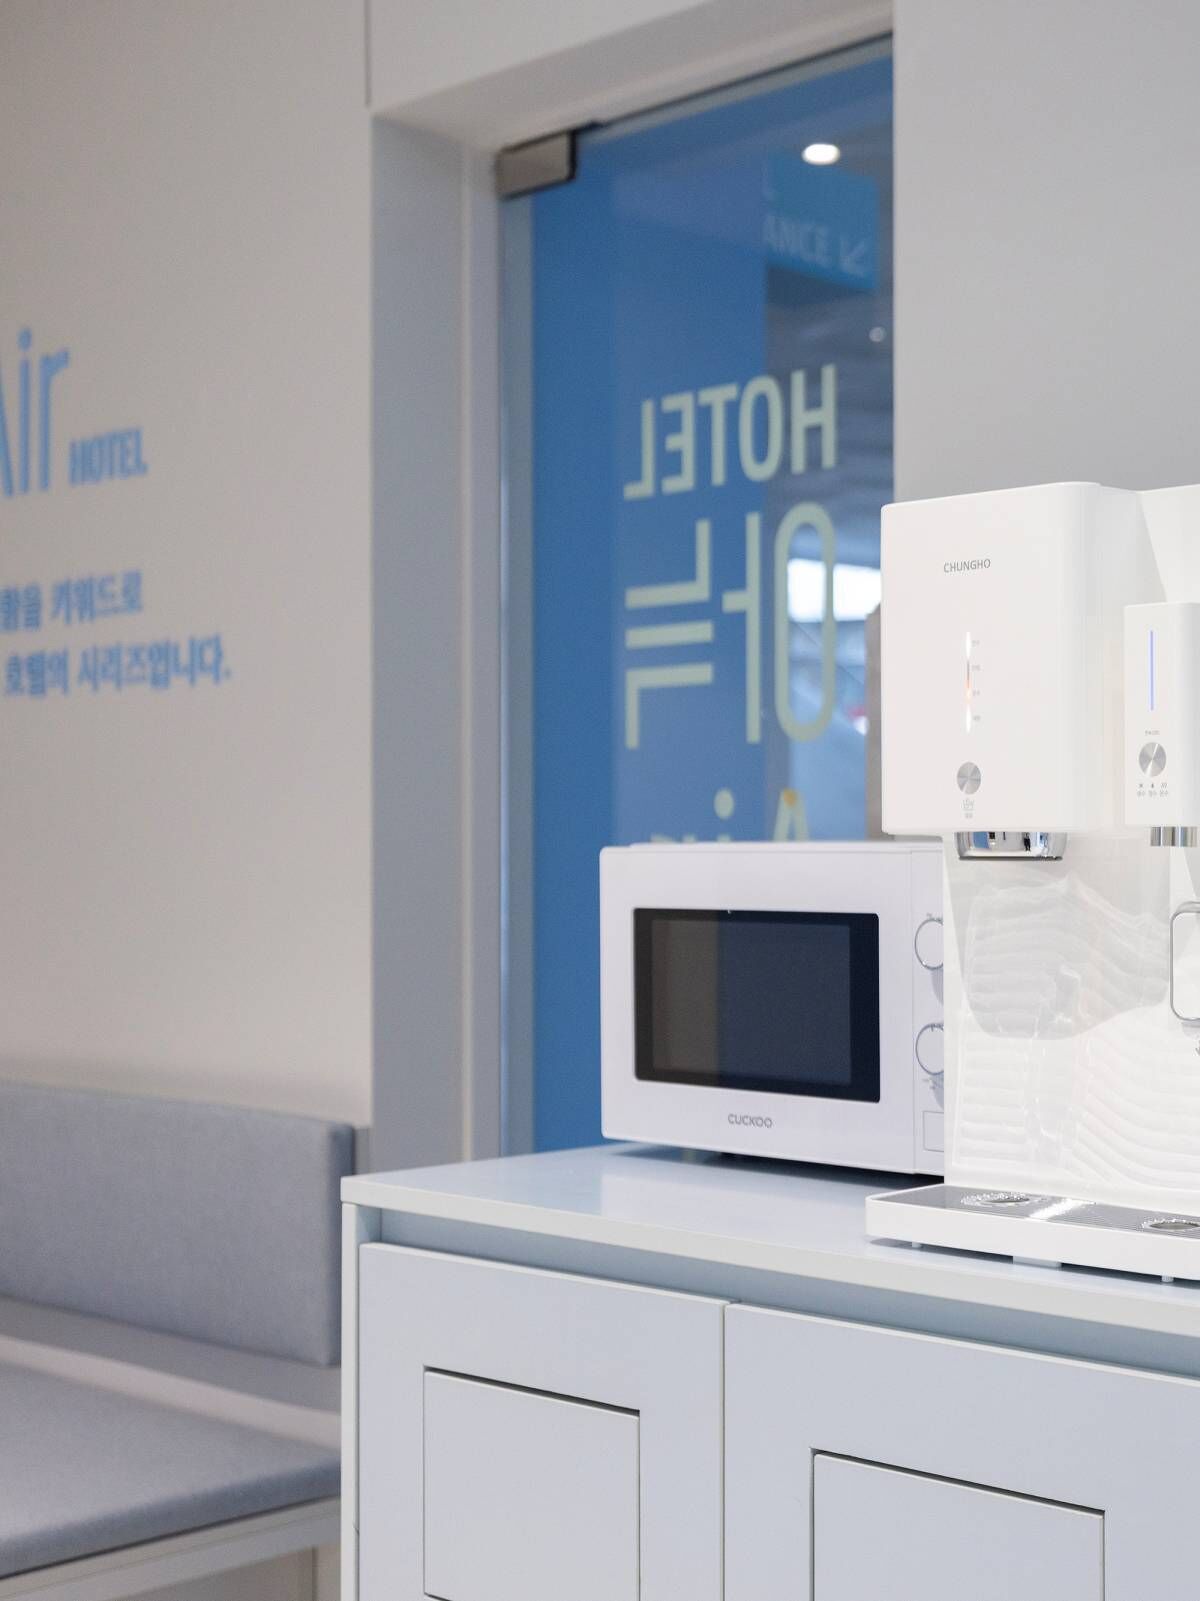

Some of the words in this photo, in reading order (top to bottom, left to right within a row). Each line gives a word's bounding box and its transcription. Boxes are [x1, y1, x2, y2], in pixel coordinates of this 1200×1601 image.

[69, 428, 148, 486] HOTEL
[943, 558, 991, 573] CHUNGHO
[51, 570, 143, 625] 키워드로
[727, 1113, 773, 1129] CUCKOO
